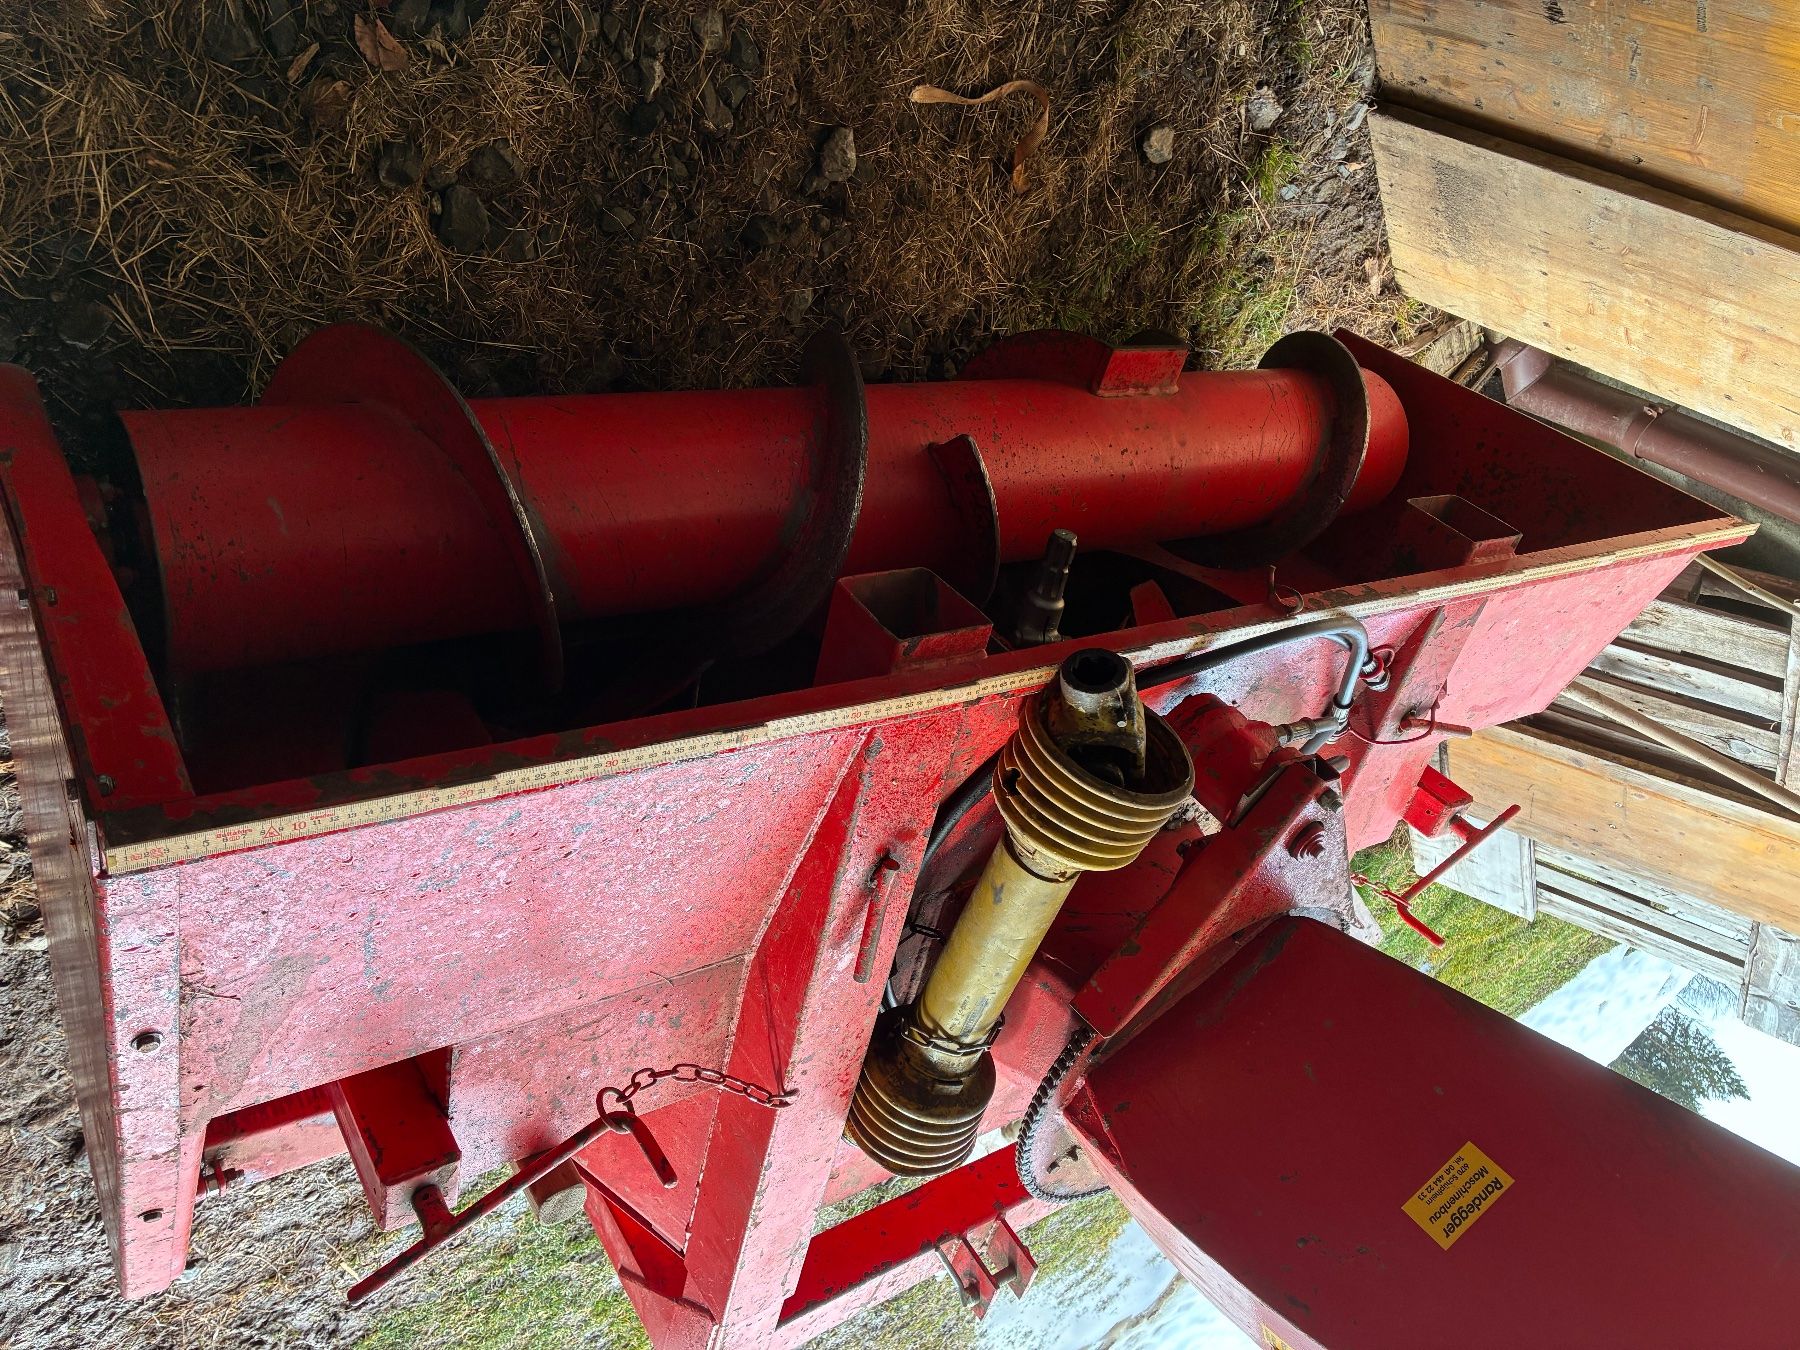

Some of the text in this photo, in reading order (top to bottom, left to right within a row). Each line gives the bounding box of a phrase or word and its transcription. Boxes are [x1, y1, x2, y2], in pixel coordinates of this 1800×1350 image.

[1457, 1163, 1470, 1176] 6170
[1425, 1184, 1435, 1194] 22
[1429, 1166, 1489, 1224] Maschinenbau
[1417, 1192, 1427, 1201] 33
[1442, 1177, 1504, 1238] Randegger
